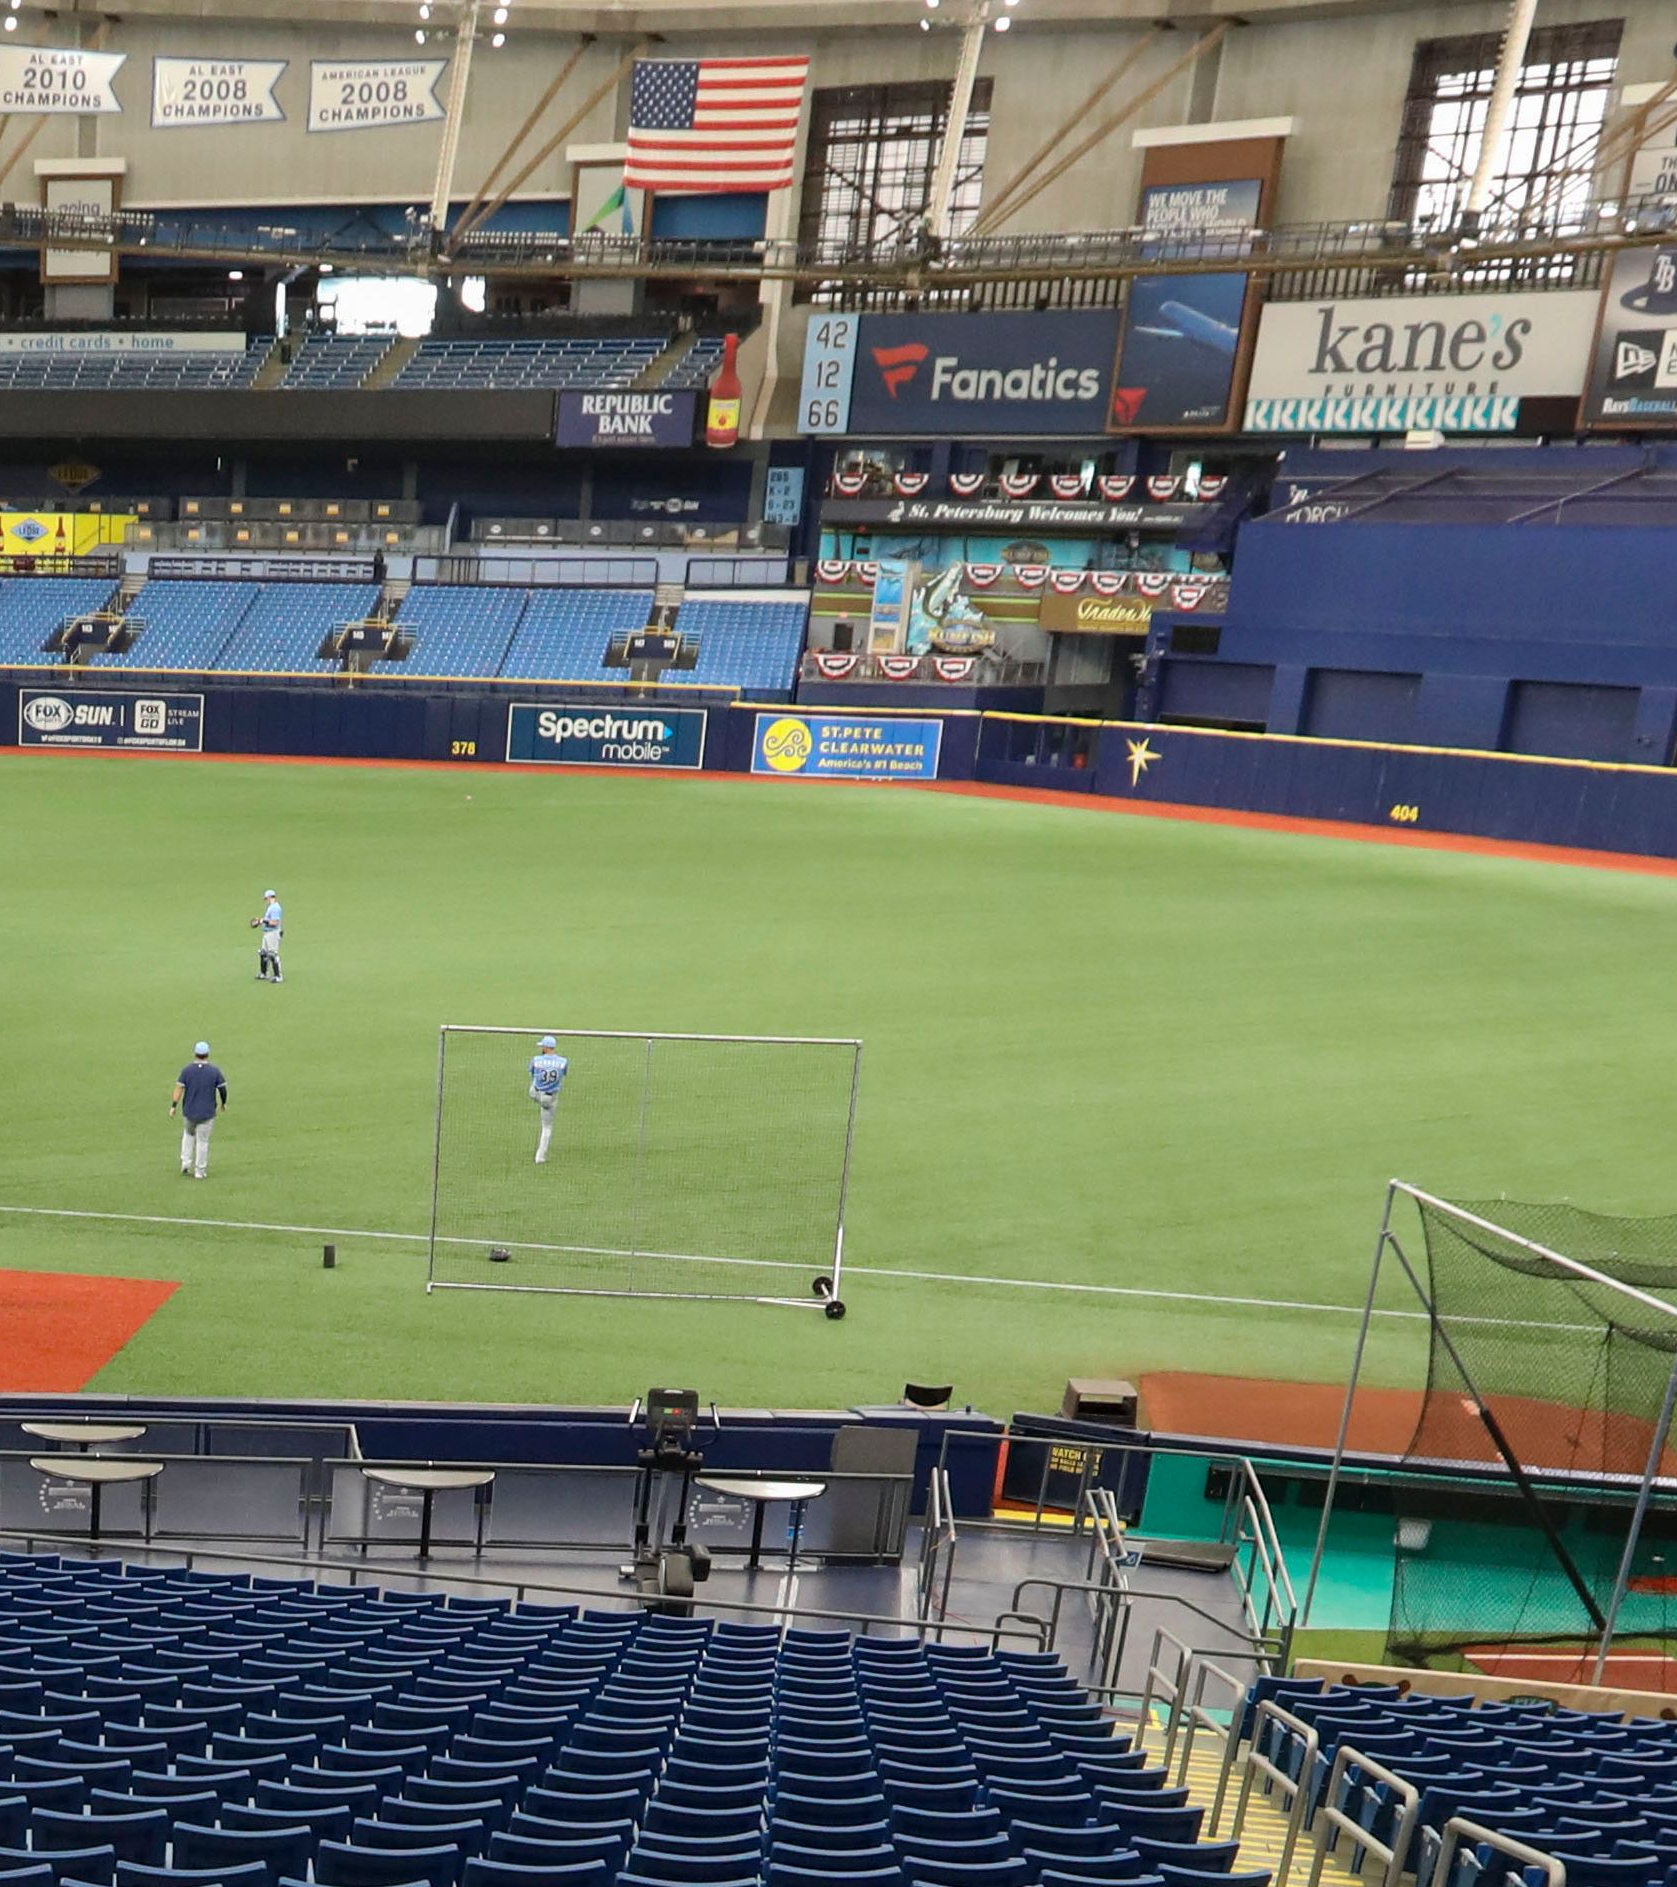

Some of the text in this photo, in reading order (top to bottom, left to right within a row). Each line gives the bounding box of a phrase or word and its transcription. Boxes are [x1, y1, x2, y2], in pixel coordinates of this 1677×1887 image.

[29, 53, 84, 67] AL EAST
[23, 67, 87, 92] 2010
[188, 64, 245, 77] AL EAST
[320, 65, 427, 81] AMERICAN LEAGUE
[2, 91, 102, 109] CHAMPIONS
[182, 79, 247, 102] 2008
[340, 79, 409, 105] 2008
[161, 103, 264, 119] CHAMPIONS
[319, 103, 425, 123] CHAMPIONS
[1147, 187, 1229, 209] WE MOVE THE
[1146, 204, 1219, 226] PEOPLE WHO
[1654, 254, 1677, 294] TB
[20, 334, 66, 349] credit
[68, 334, 112, 349] cards
[131, 334, 175, 350] home
[815, 321, 849, 350] 42
[1307, 305, 1533, 374] kane's
[815, 360, 840, 389] 12
[931, 356, 1100, 403] Fanatics
[1324, 381, 1500, 398] FURNITURE
[581, 393, 673, 415] REPUBLIC
[808, 400, 840, 428] 66
[597, 413, 653, 435] BANK
[908, 503, 931, 519] St.
[935, 504, 1024, 523] Petersburg
[1028, 506, 1106, 522] Welcomes
[1108, 506, 1143, 523] You!
[35, 703, 114, 726] FOX SUN
[140, 704, 160, 715] FOX
[167, 708, 200, 718] STREAM
[140, 718, 159, 729] GO
[167, 718, 184, 726] LIVE
[538, 710, 665, 745] Spectrum
[452, 740, 476, 755] 378
[819, 741, 926, 757] CLEARWATER
[818, 757, 872, 771] America's
[889, 759, 924, 772] Beach
[1390, 803, 1419, 822] 404
[540, 1069, 558, 1083] 39
